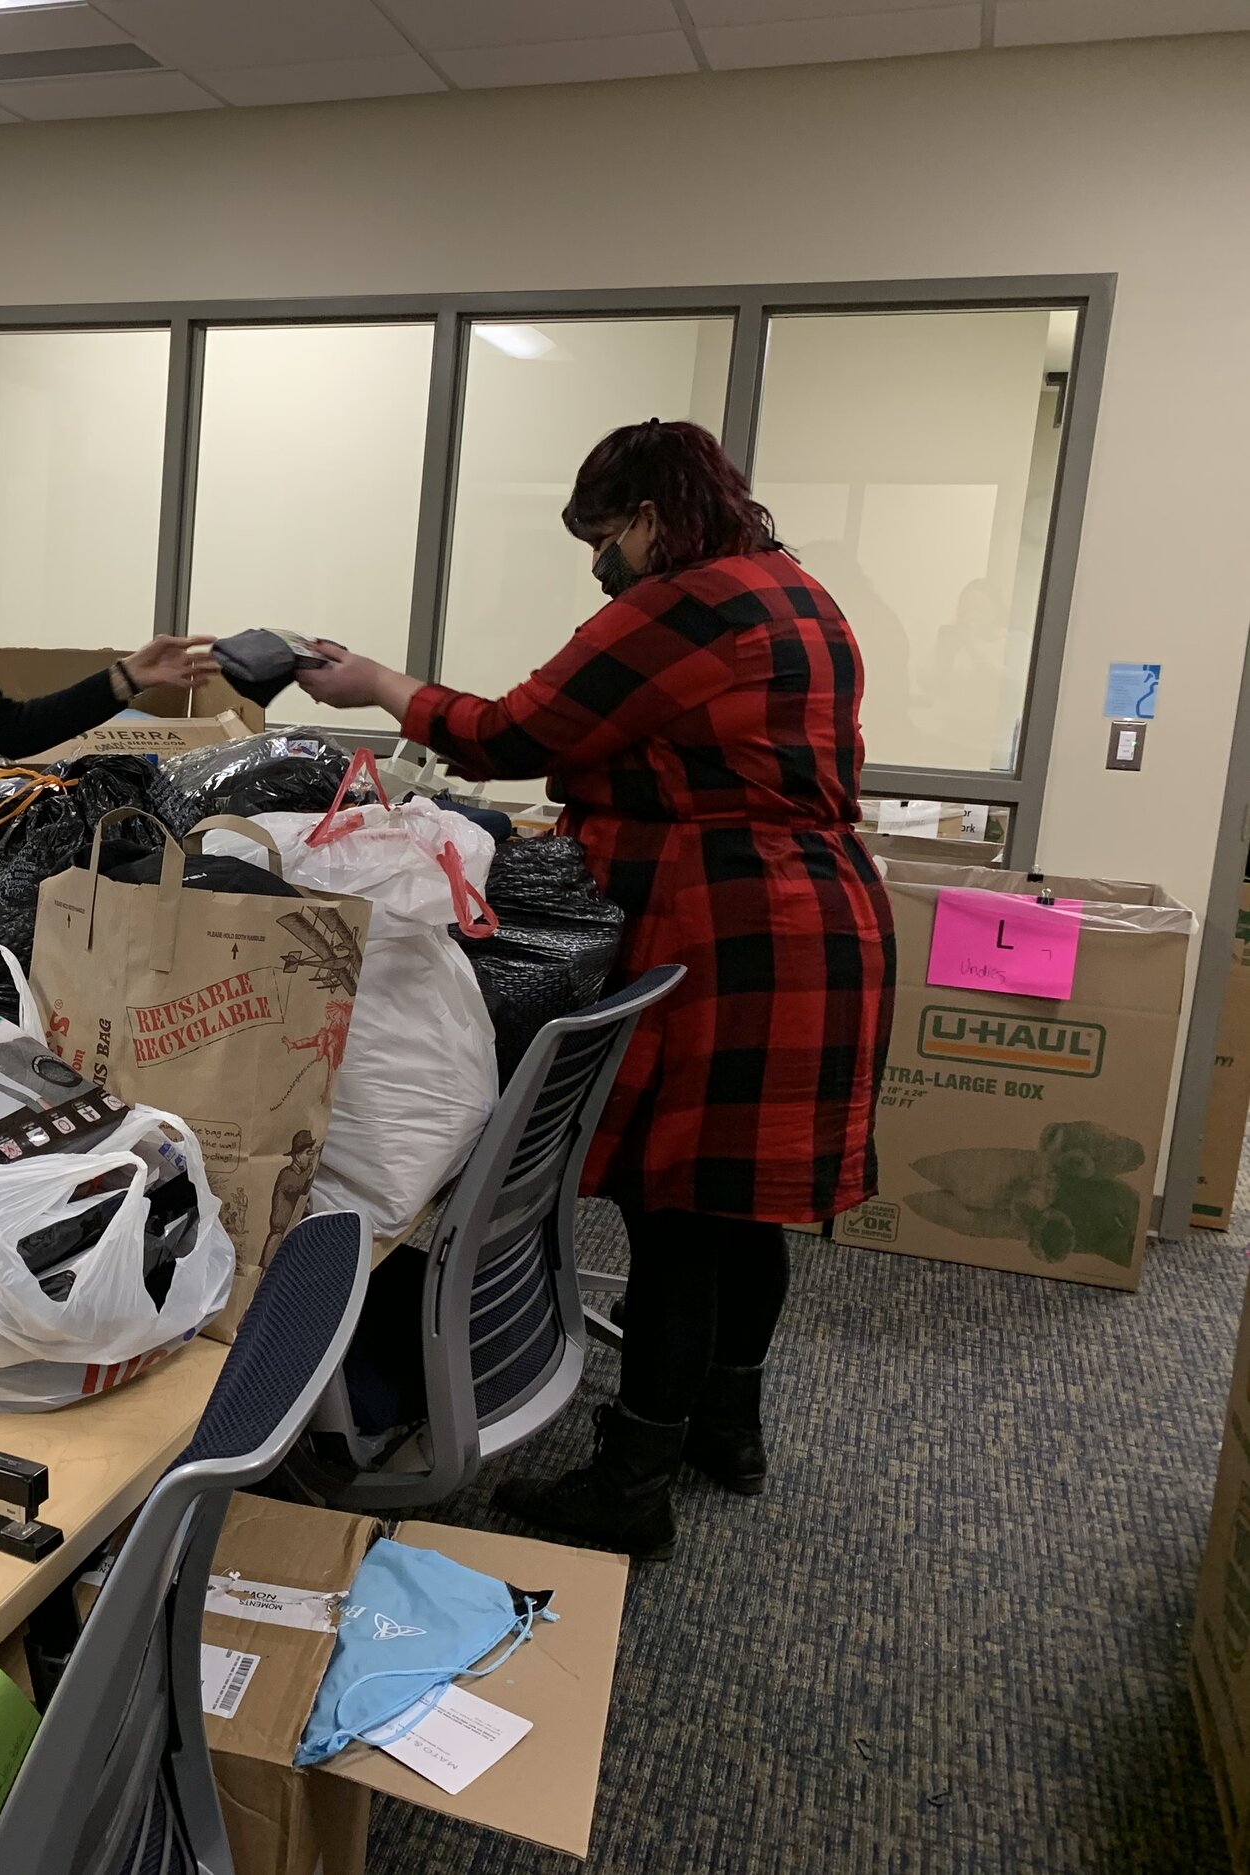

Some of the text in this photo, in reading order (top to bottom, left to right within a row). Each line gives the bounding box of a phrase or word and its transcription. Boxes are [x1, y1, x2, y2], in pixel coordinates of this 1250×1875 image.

[94, 730, 182, 741] SIERRA
[996, 919, 1014, 950] L
[134, 971, 254, 1034] REUSABLE
[96, 1017, 112, 1059] BAG
[132, 996, 272, 1063] RECYCLABLE
[932, 1015, 1092, 1056] U-HAUL
[1004, 1080, 1045, 1101] BOX
[899, 1098, 915, 1109] FT
[204, 1128, 222, 1138] bag
[201, 1139, 236, 1149] the wall
[864, 1217, 892, 1232] OK
[238, 1599, 283, 1612] MOMENTS
[422, 1745, 458, 1771] MATO
